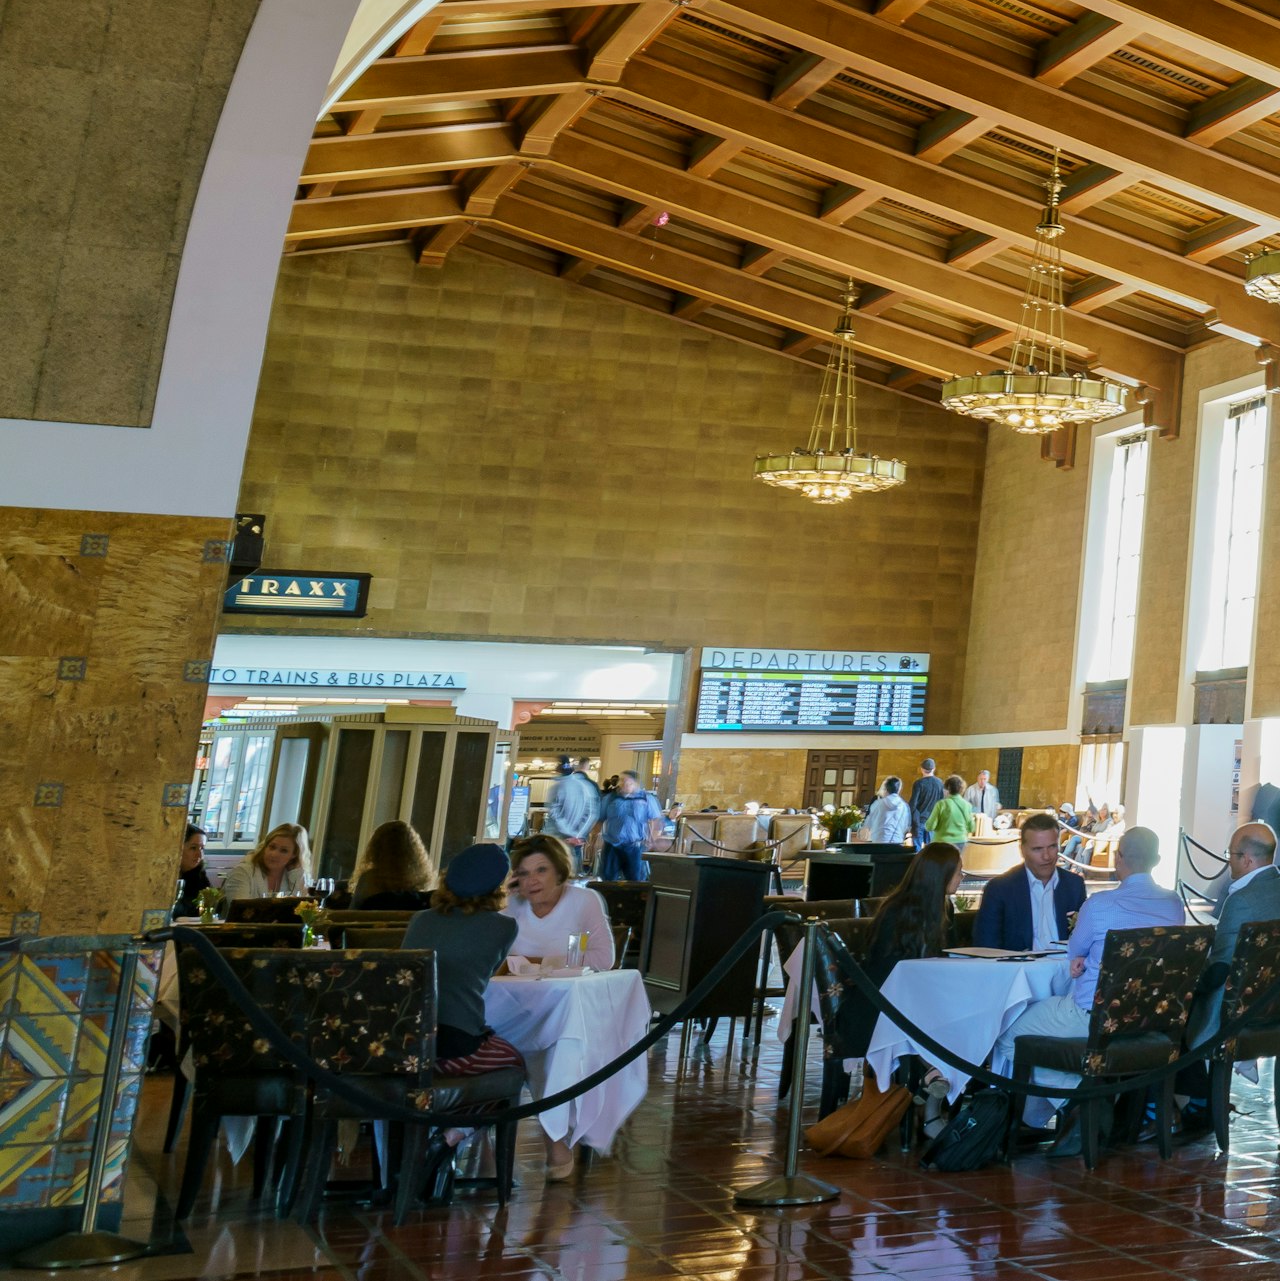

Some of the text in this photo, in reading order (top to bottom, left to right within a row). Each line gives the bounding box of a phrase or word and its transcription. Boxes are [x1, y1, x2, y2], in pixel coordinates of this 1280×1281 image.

[240, 578, 346, 597] TRAXX
[711, 651, 888, 672] DEPARTURES
[210, 668, 456, 687] TO TRAINS & BUS PLAZA
